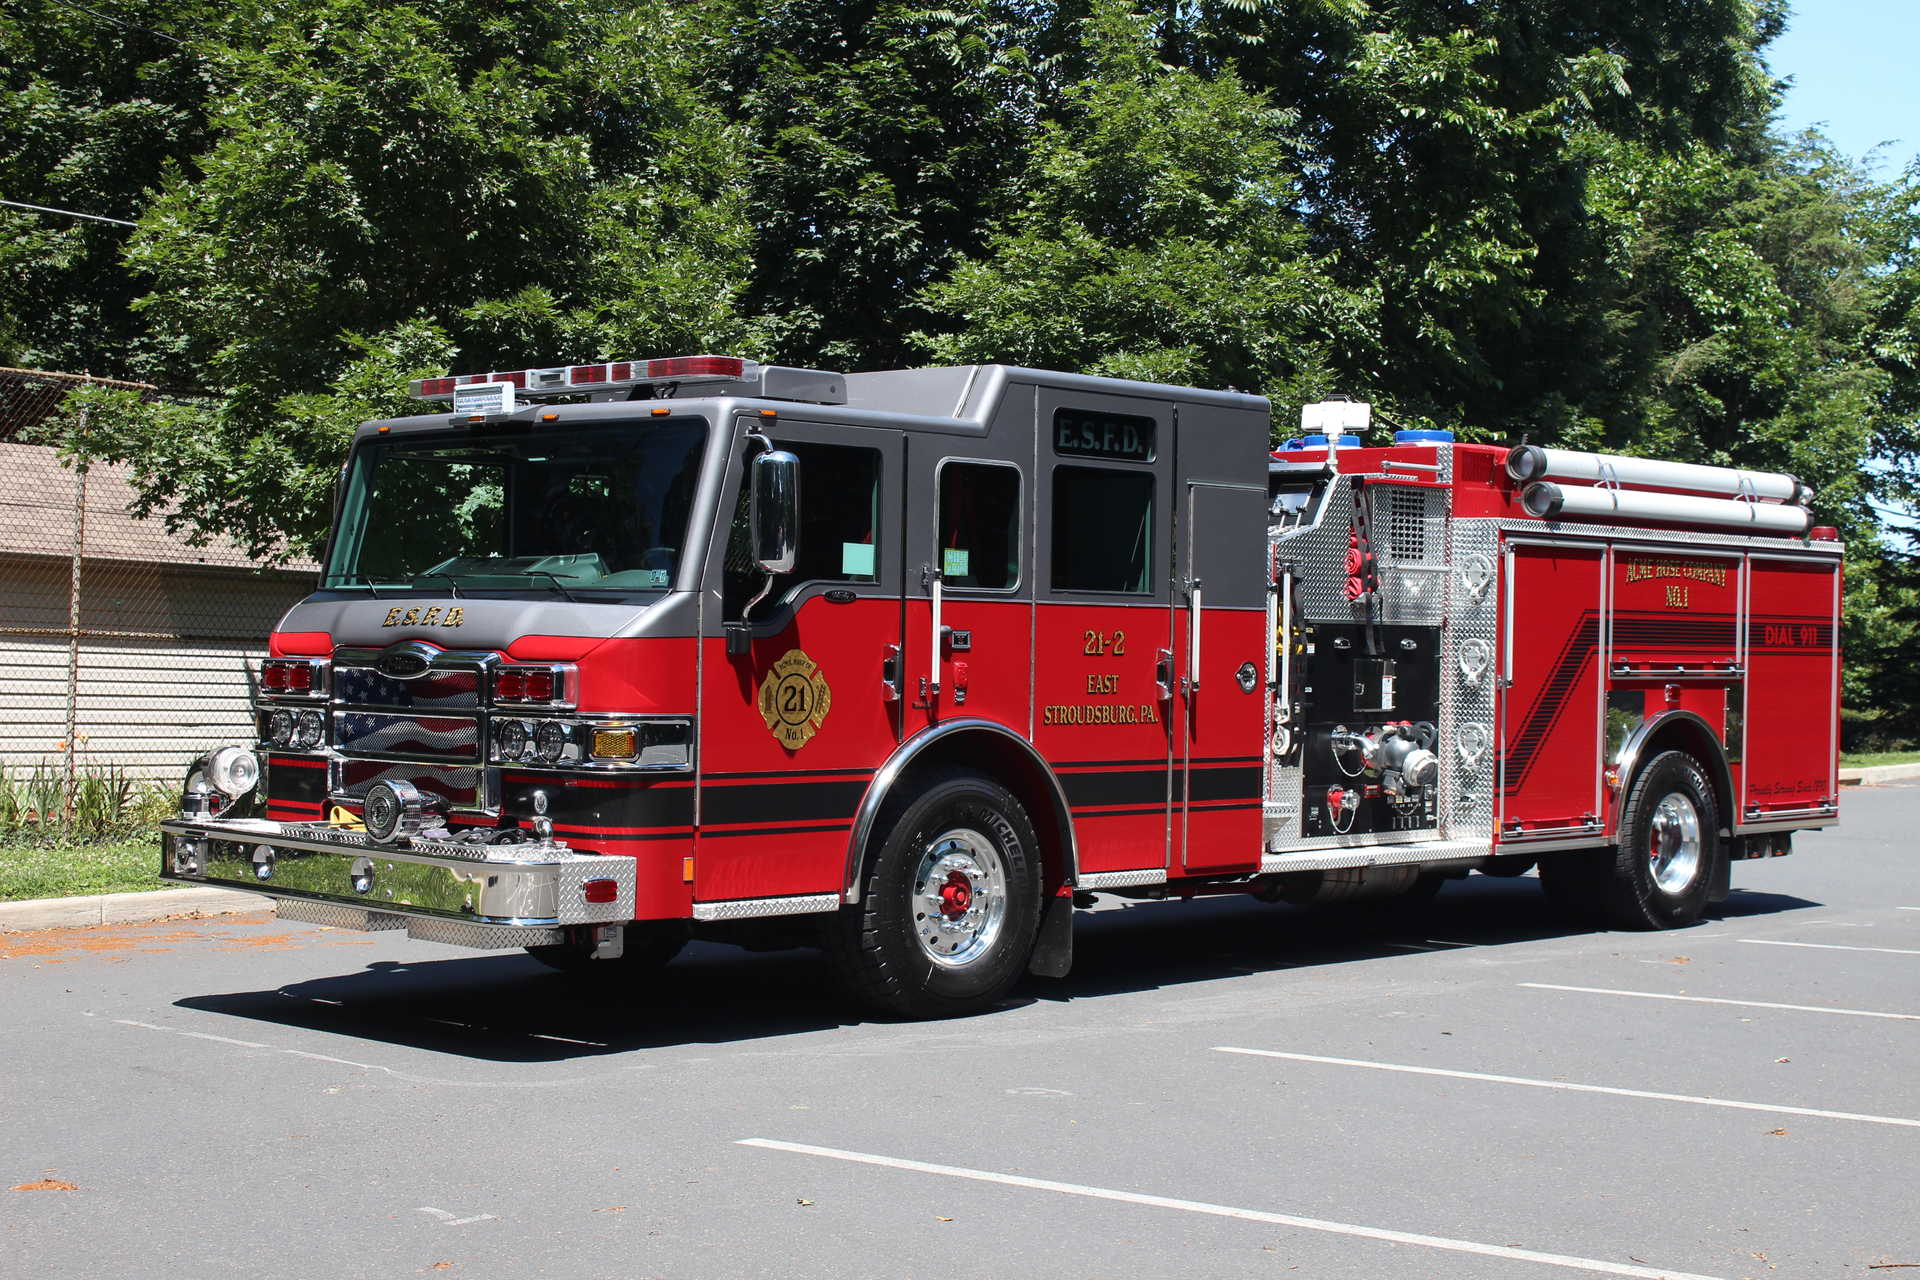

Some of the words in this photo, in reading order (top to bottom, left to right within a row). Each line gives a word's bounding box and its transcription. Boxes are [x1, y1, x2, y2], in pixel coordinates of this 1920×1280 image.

[1058, 418, 1144, 453] E.S.F.D.
[1625, 558, 1654, 584] ACME
[1655, 559, 1681, 578] HOSE
[1683, 561, 1727, 588] COMPANY
[381, 606, 465, 628] E.S.F.D.
[1084, 629, 1125, 656] 21-2
[1765, 625, 1795, 645] DIAL
[1800, 627, 1818, 645] 911
[793, 658, 806, 667] HOSE
[1086, 674, 1119, 694] EAST
[784, 685, 807, 712] 21
[1043, 705, 1138, 725] STROUDSBURG,
[1140, 705, 1159, 723] PA.
